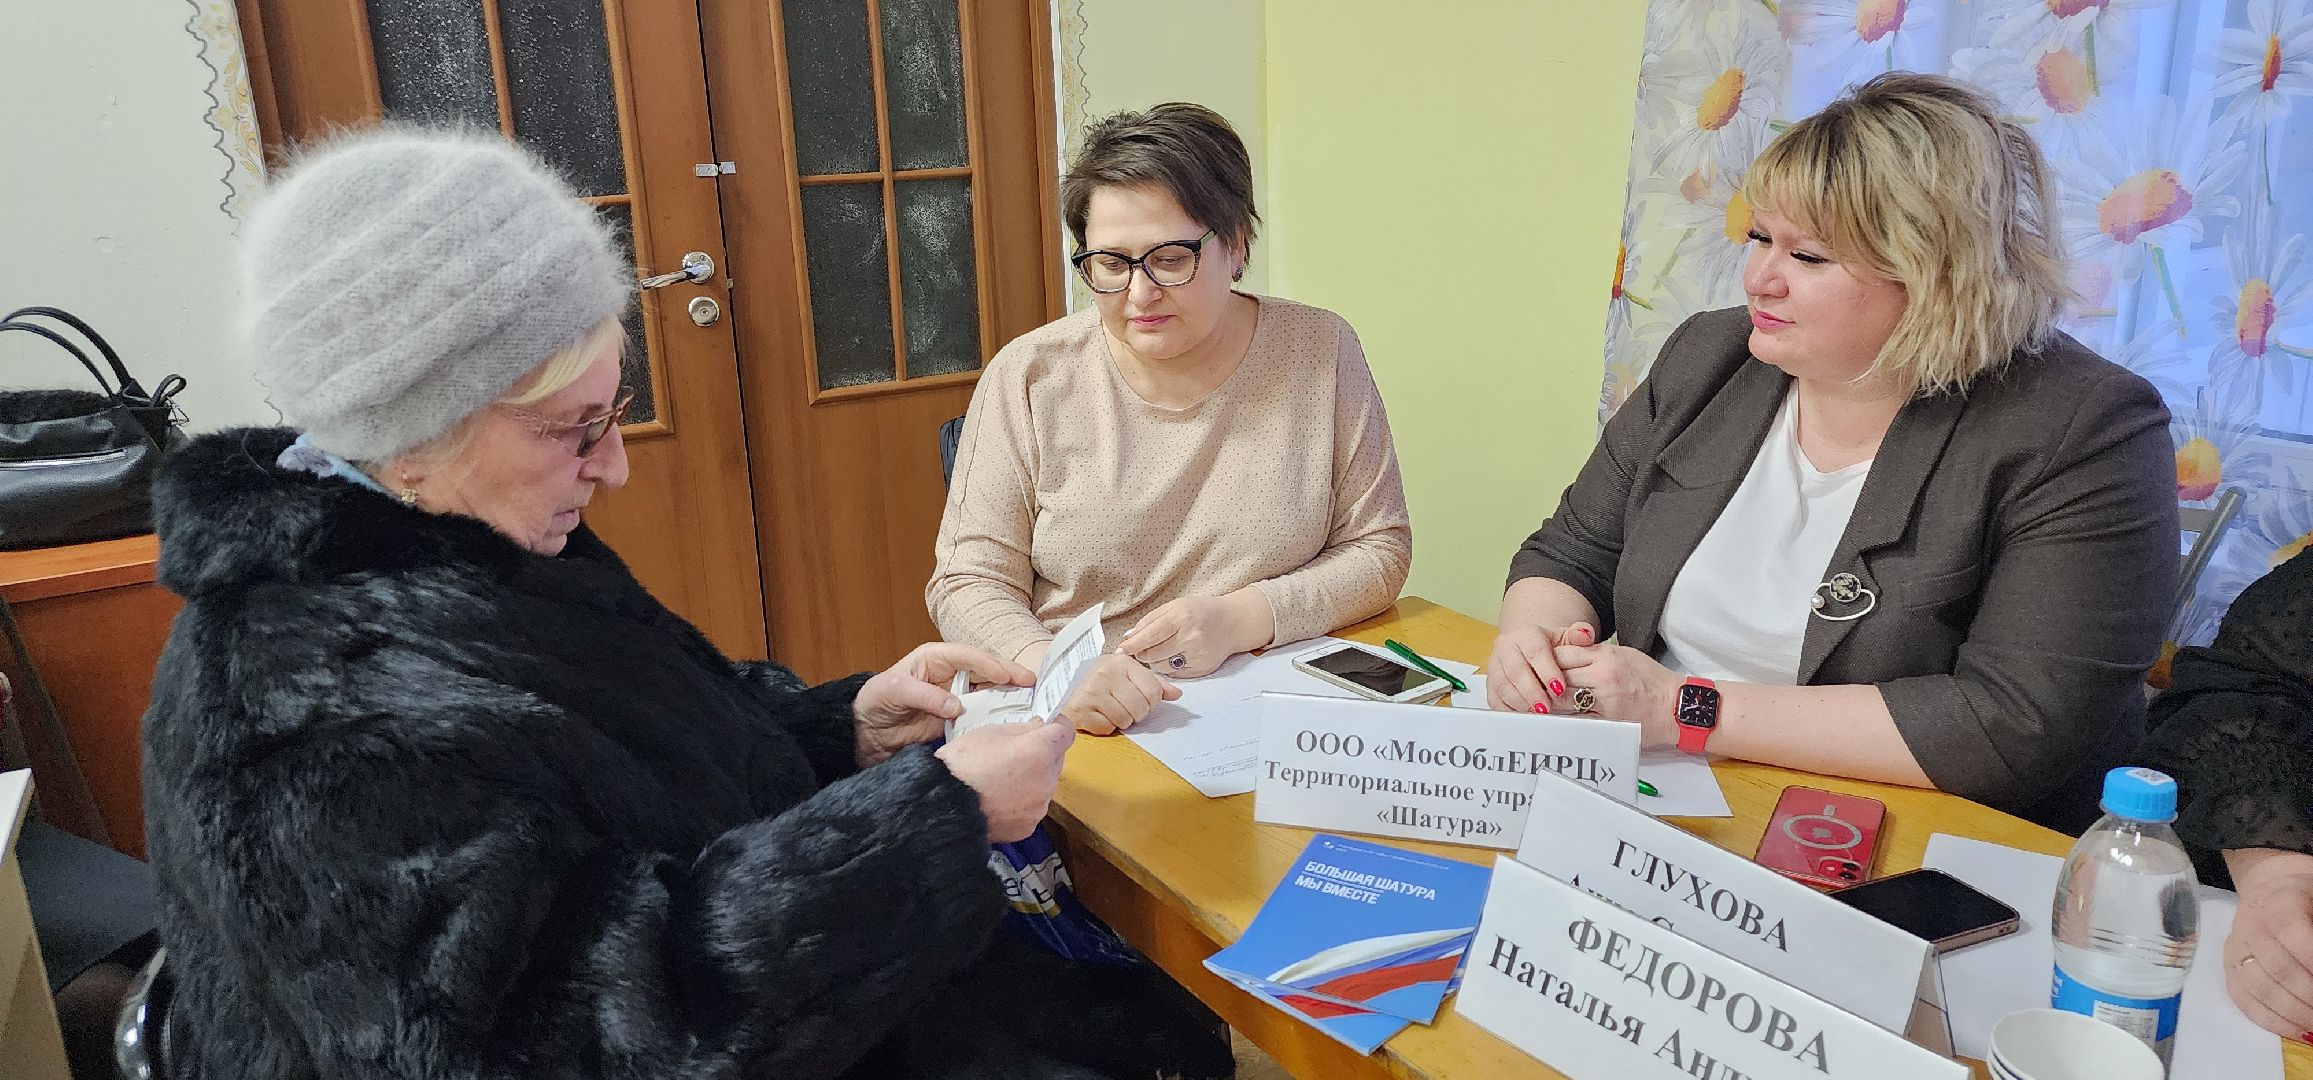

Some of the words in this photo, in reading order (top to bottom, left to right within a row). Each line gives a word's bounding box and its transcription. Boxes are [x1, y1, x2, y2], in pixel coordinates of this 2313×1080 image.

[1264, 760, 1475, 801] Территориальное
[1296, 730, 1365, 758] ООО
[1373, 738, 1616, 788] «МосОблЕИРЦ»
[1376, 804, 1503, 838] «Шатура»
[1294, 874, 1323, 891] МЫ
[1321, 881, 1381, 905] ВМЕСТЕ
[1304, 861, 1376, 886] БОЛЬШАЯ
[1374, 878, 1436, 900] ШАТУРА
[1609, 837, 1788, 953] ГЛУХОВА
[1488, 934, 1647, 1046] Наталья
[1568, 915, 1831, 1075] ФЕДОРОВА
